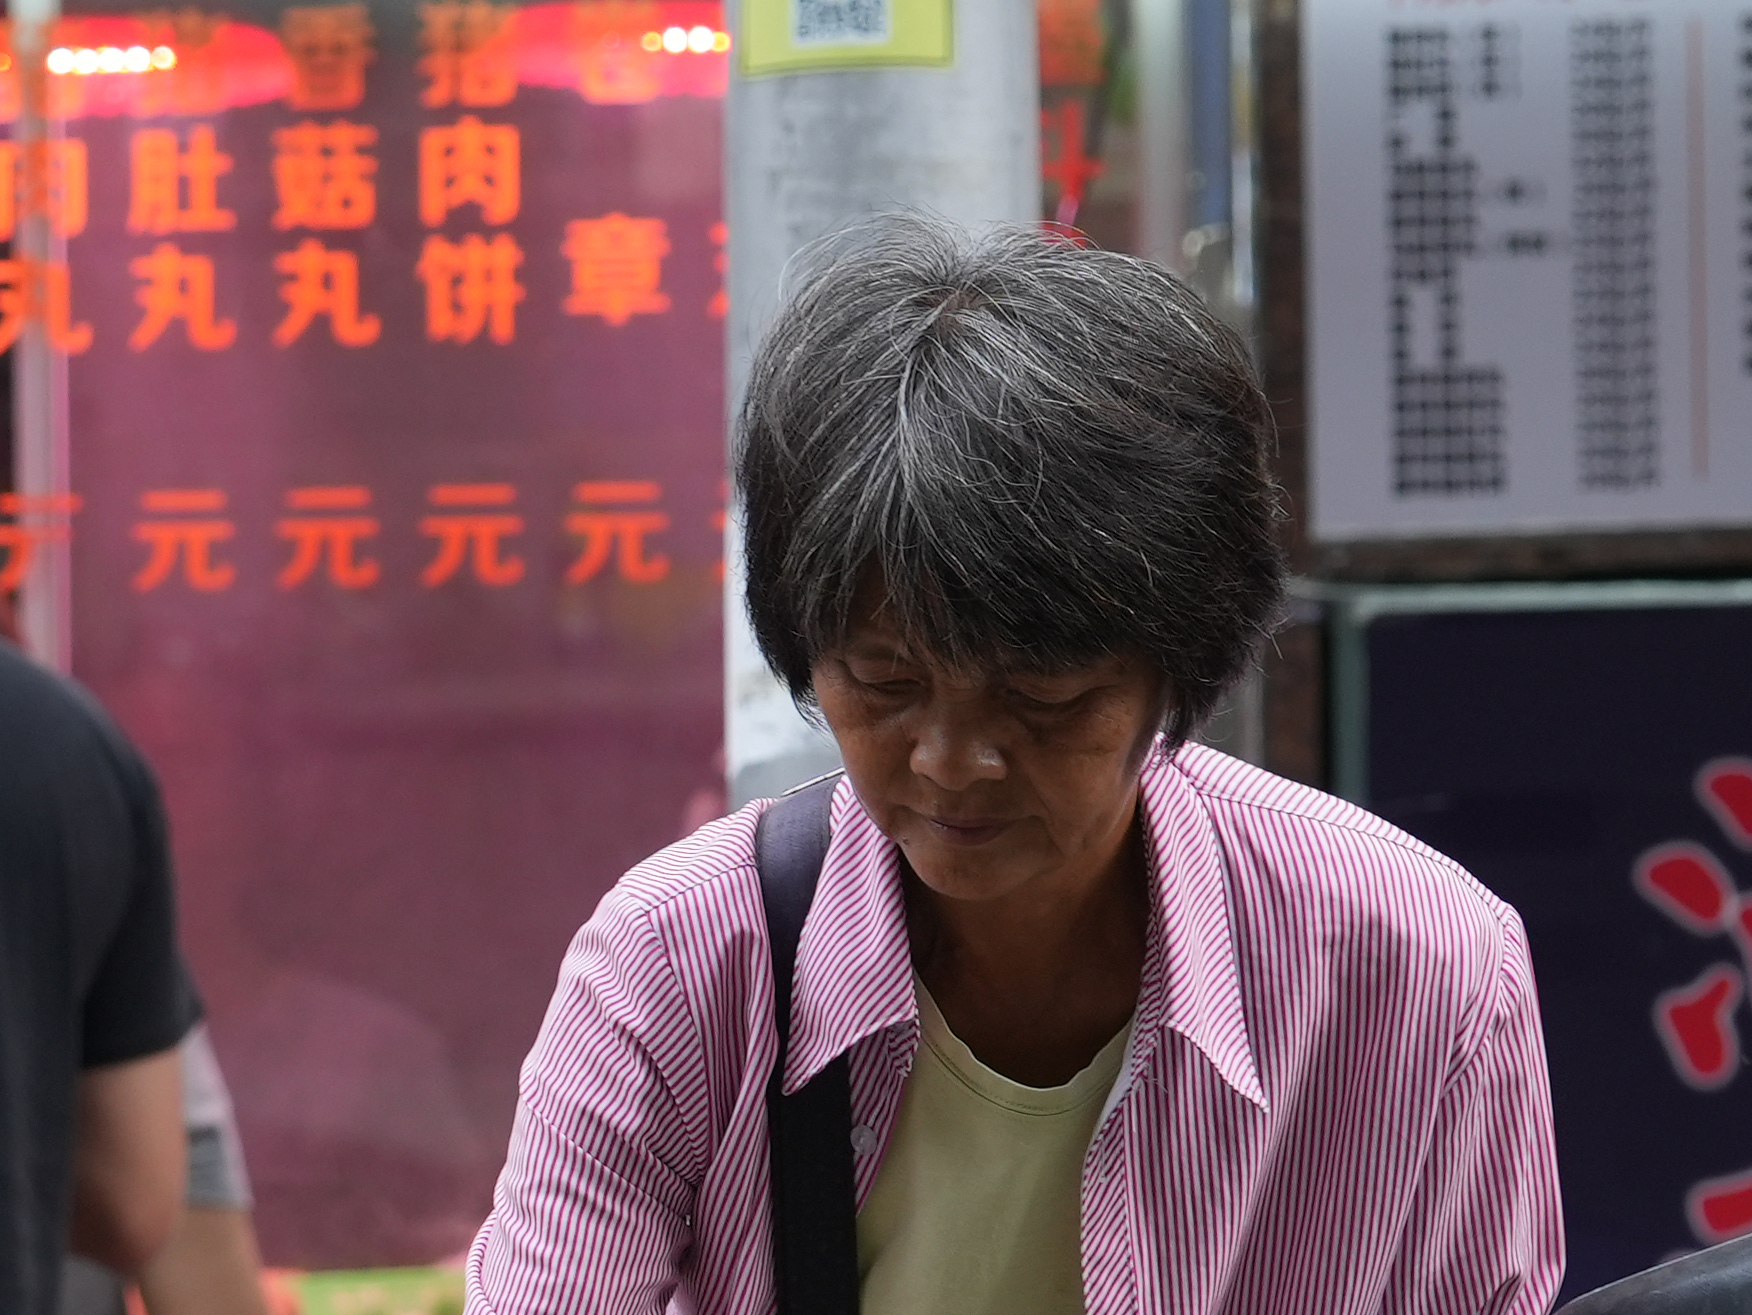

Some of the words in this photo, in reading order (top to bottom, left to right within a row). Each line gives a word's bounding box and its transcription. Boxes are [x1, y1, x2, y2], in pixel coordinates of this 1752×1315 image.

[131, 488, 237, 593] 元
[275, 486, 383, 591] 元
[420, 484, 525, 588] 元
[564, 480, 672, 586] 元
